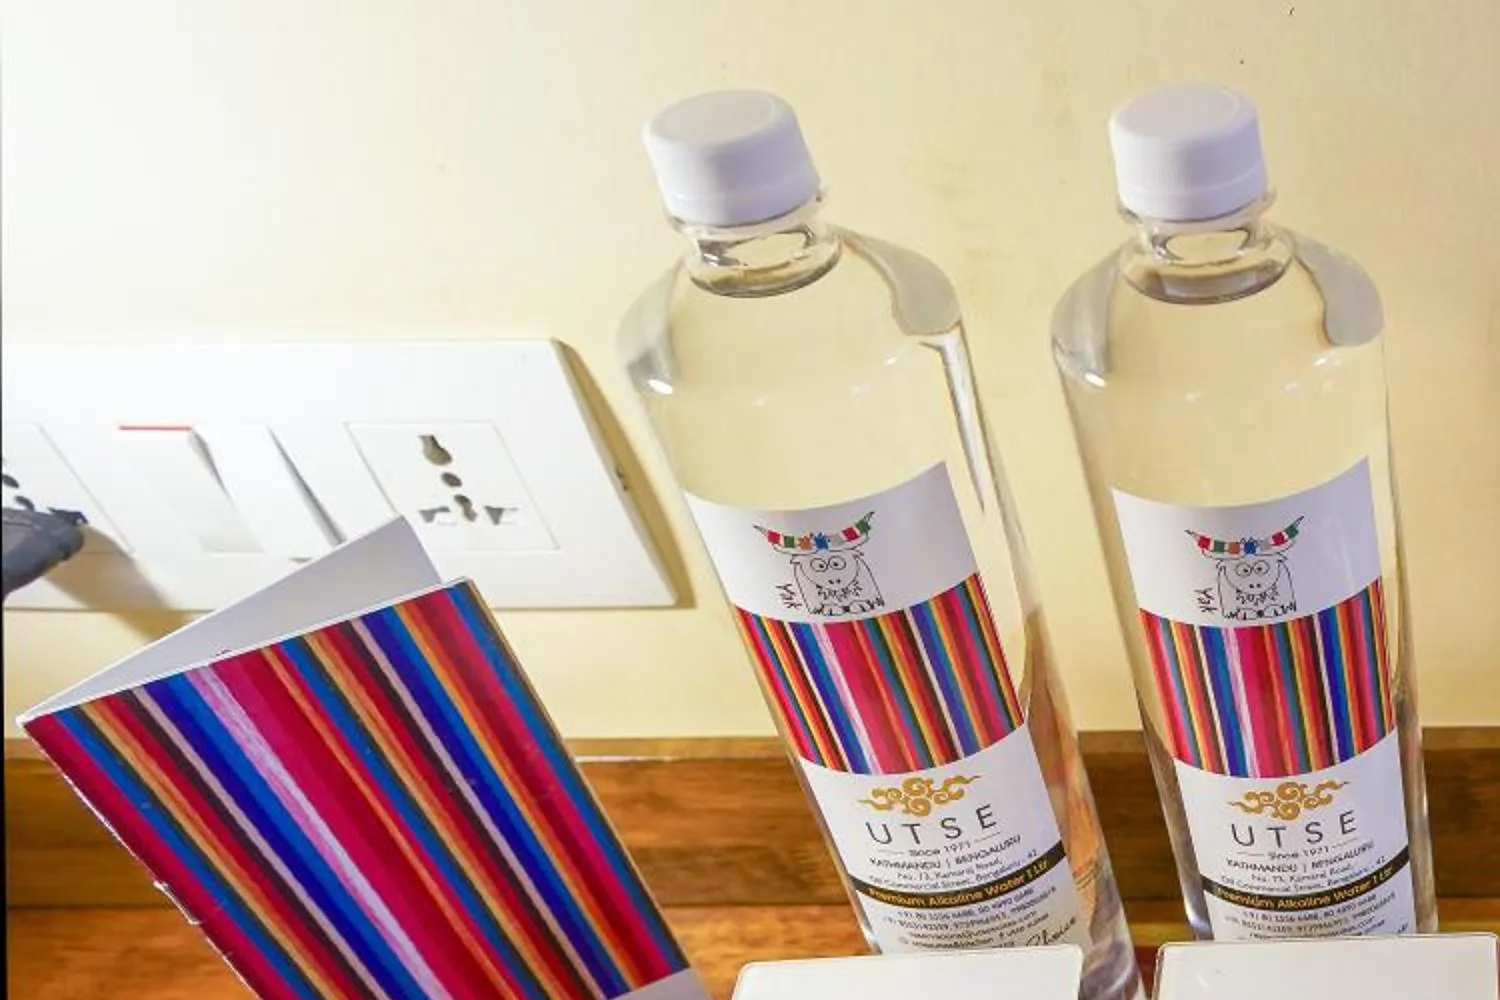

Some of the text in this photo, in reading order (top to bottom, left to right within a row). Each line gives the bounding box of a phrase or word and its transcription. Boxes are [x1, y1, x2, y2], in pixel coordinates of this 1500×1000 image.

[865, 804, 999, 845] UTSE
[1231, 810, 1358, 848] UTSE
[1226, 858, 1298, 873] KATHMANDU
[929, 890, 983, 906] Alkaline
[985, 875, 1026, 896] Water
[1277, 895, 1331, 910] Alkaline
[1333, 880, 1371, 901] Water
